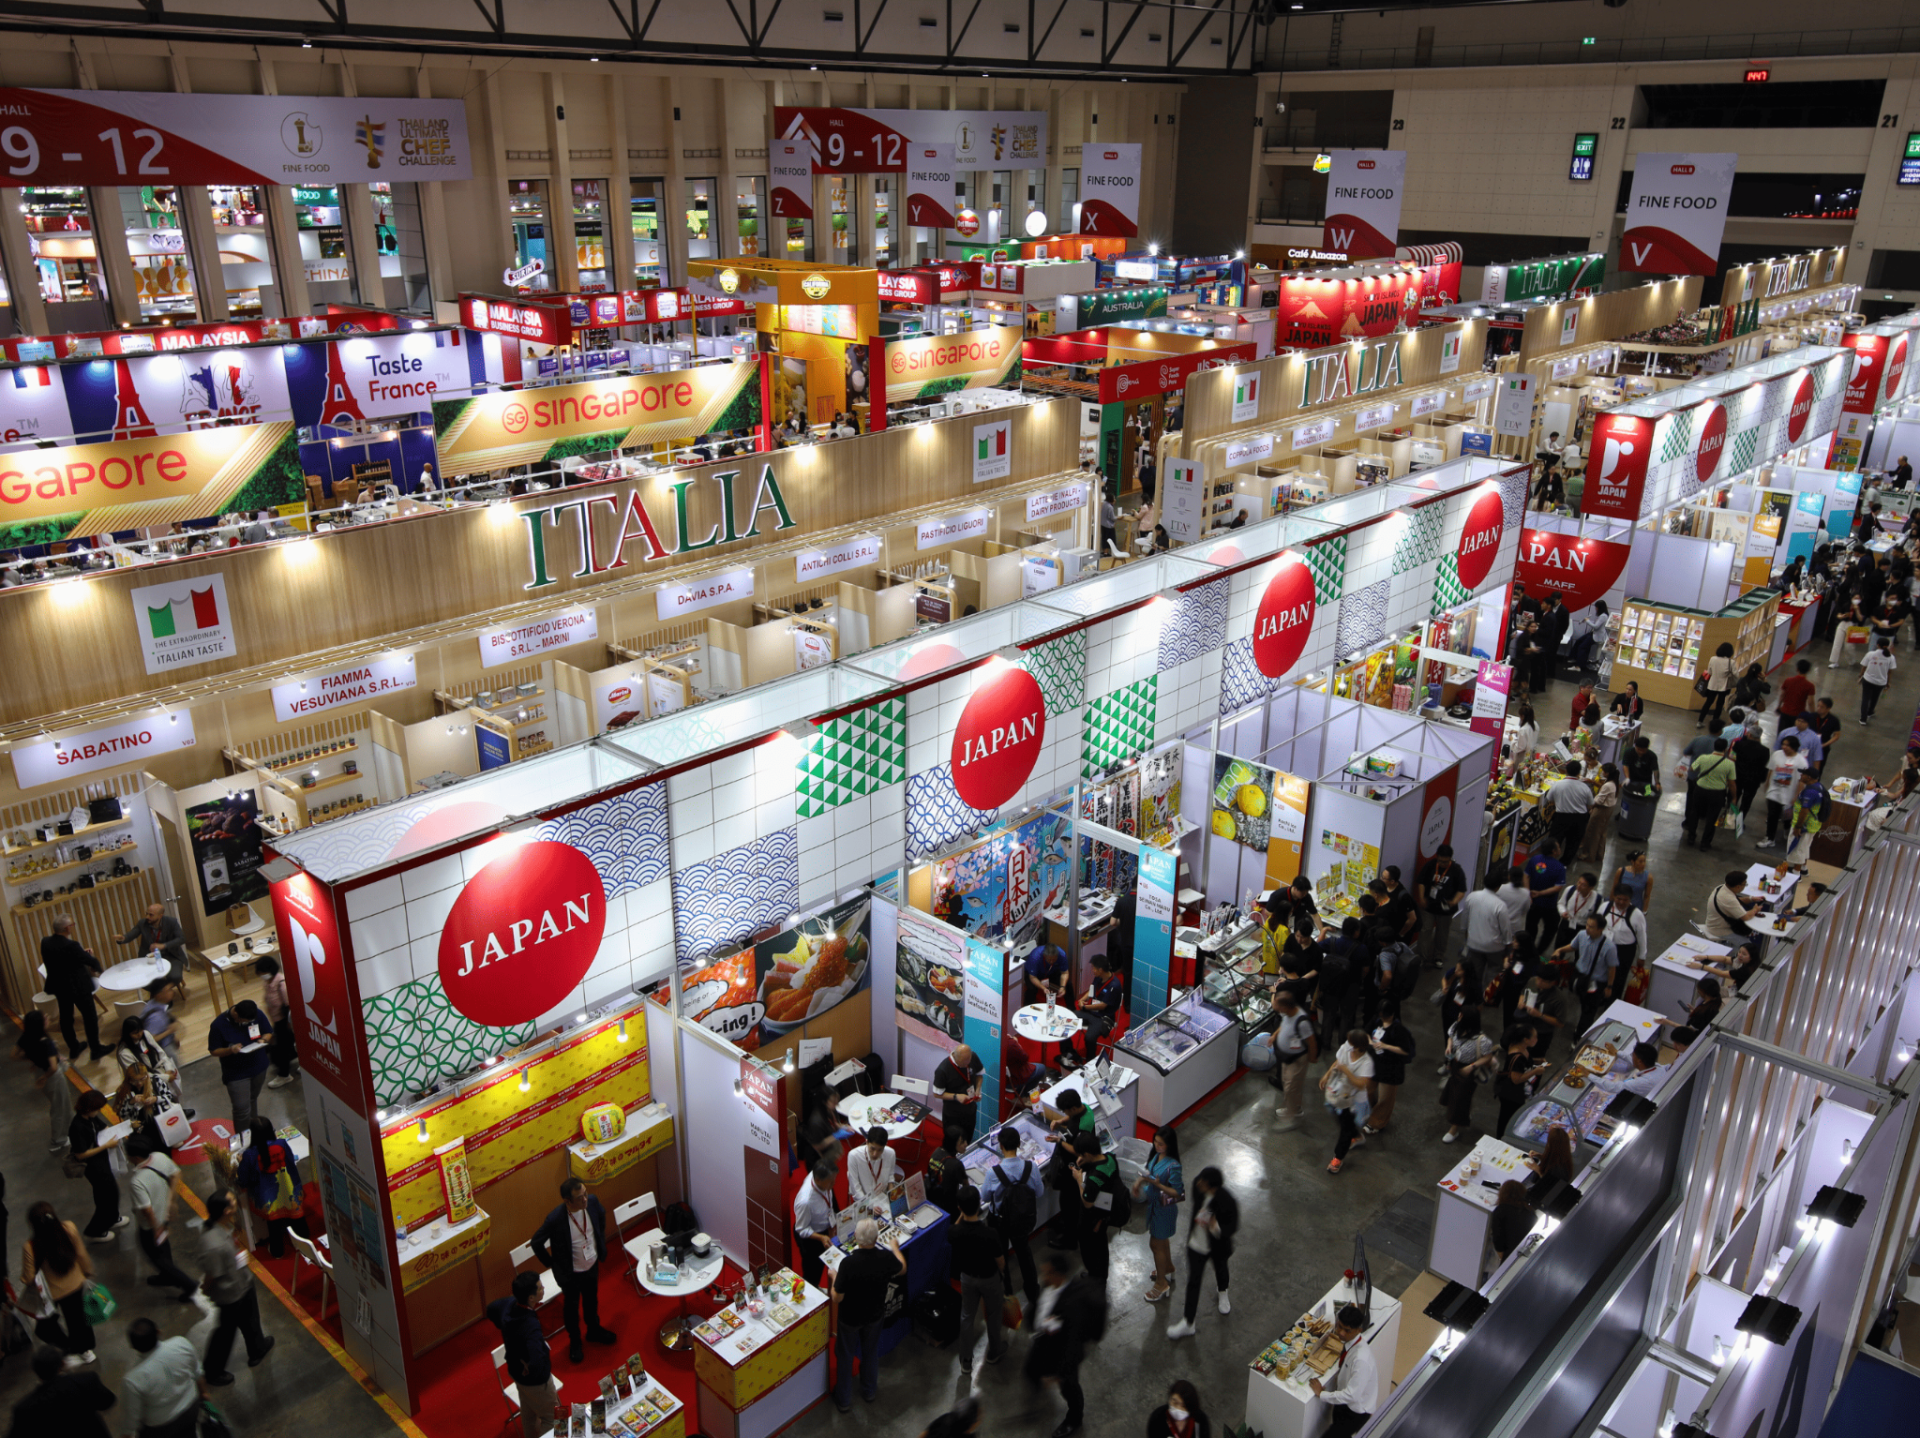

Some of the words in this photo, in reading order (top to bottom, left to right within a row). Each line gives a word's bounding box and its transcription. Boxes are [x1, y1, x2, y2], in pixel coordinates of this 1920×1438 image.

[397, 119, 449, 129] THAILAND
[830, 119, 844, 127] HALL
[1393, 120, 1404, 130] 23
[1612, 117, 1626, 129] 22
[1881, 114, 1898, 128] 21
[401, 130, 449, 138] ULTIMATE
[1, 126, 40, 176] 9
[98, 128, 170, 175] 12
[401, 139, 451, 155] CHEF
[828, 133, 845, 166] 9
[872, 134, 901, 165] 12
[1012, 140, 1038, 151] CHEF
[283, 164, 303, 172] FINE
[304, 164, 331, 173] FOOD
[398, 156, 457, 166] CHALLENGE
[774, 167, 787, 175] FINE
[788, 168, 807, 176] FOOD
[911, 172, 927, 181] FINE
[929, 173, 950, 181] FOOD
[1087, 176, 1105, 185] FINE
[1107, 176, 1134, 186] FOOD
[1335, 187, 1358, 198] FINE
[1360, 188, 1393, 199] FOOD
[1639, 196, 1669, 208] FINE
[1673, 196, 1718, 209] FOOD
[775, 198, 785, 213] Z
[911, 205, 921, 222] Y
[1085, 212, 1098, 231] X
[1330, 228, 1355, 249] W
[1288, 249, 1308, 259] Café
[1309, 250, 1347, 260] Amazon
[1630, 242, 1653, 266] V
[304, 268, 349, 282] HINA
[878, 275, 917, 290] LAYSIA
[1521, 266, 1559, 294] ITALIA
[1765, 258, 1810, 298] ITALIA
[894, 290, 917, 299] GROUP
[489, 305, 542, 328] MALAYSIA
[1102, 301, 1144, 313] AUSTRALIA
[1359, 301, 1399, 326] JAPAN
[490, 320, 519, 333] BUSINESS
[521, 326, 543, 338] GROUP
[1285, 329, 1331, 346] JAPAN
[161, 330, 250, 350] MALAYSIA
[366, 353, 423, 377] Taste
[1298, 341, 1404, 410] ITALIA
[368, 379, 437, 402] France
[1791, 397, 1813, 419] JAPAN
[1699, 432, 1725, 455] JAPAN
[1597, 486, 1627, 499] JAPAN
[1031, 505, 1048, 518] DAIRY
[1049, 497, 1080, 513] PRODUCTS
[519, 463, 797, 590] ITALIA
[921, 525, 957, 541] PASTIFICIO
[957, 518, 984, 532] LIGUORI
[1461, 524, 1500, 555] JAPAN
[833, 551, 854, 564] COLLI
[1543, 578, 1576, 590] MAFF
[677, 589, 708, 605] DAVIA
[709, 583, 735, 597] S.P.A.
[491, 622, 550, 647] BISCOTTIFICIO
[551, 613, 586, 631] VERONA
[1258, 600, 1311, 641] JAPAN
[155, 640, 167, 649] THE
[170, 630, 221, 646] EXTRAORDINARY
[511, 643, 534, 656] S.R.L.
[542, 632, 570, 649] MARINI
[157, 649, 194, 665] ITALIAN
[197, 642, 224, 656] TASTE
[321, 667, 373, 690] FIAMMA
[290, 684, 367, 713] VESUVIANA
[369, 677, 404, 693] S.R.L.
[56, 731, 153, 766] SABATINO
[960, 712, 1038, 768] JAPAN
[1010, 849, 1029, 907] 日本
[456, 892, 592, 978] JAPAN
[967, 998, 989, 1014] Seafoods
[308, 1021, 342, 1063] JAPAN
